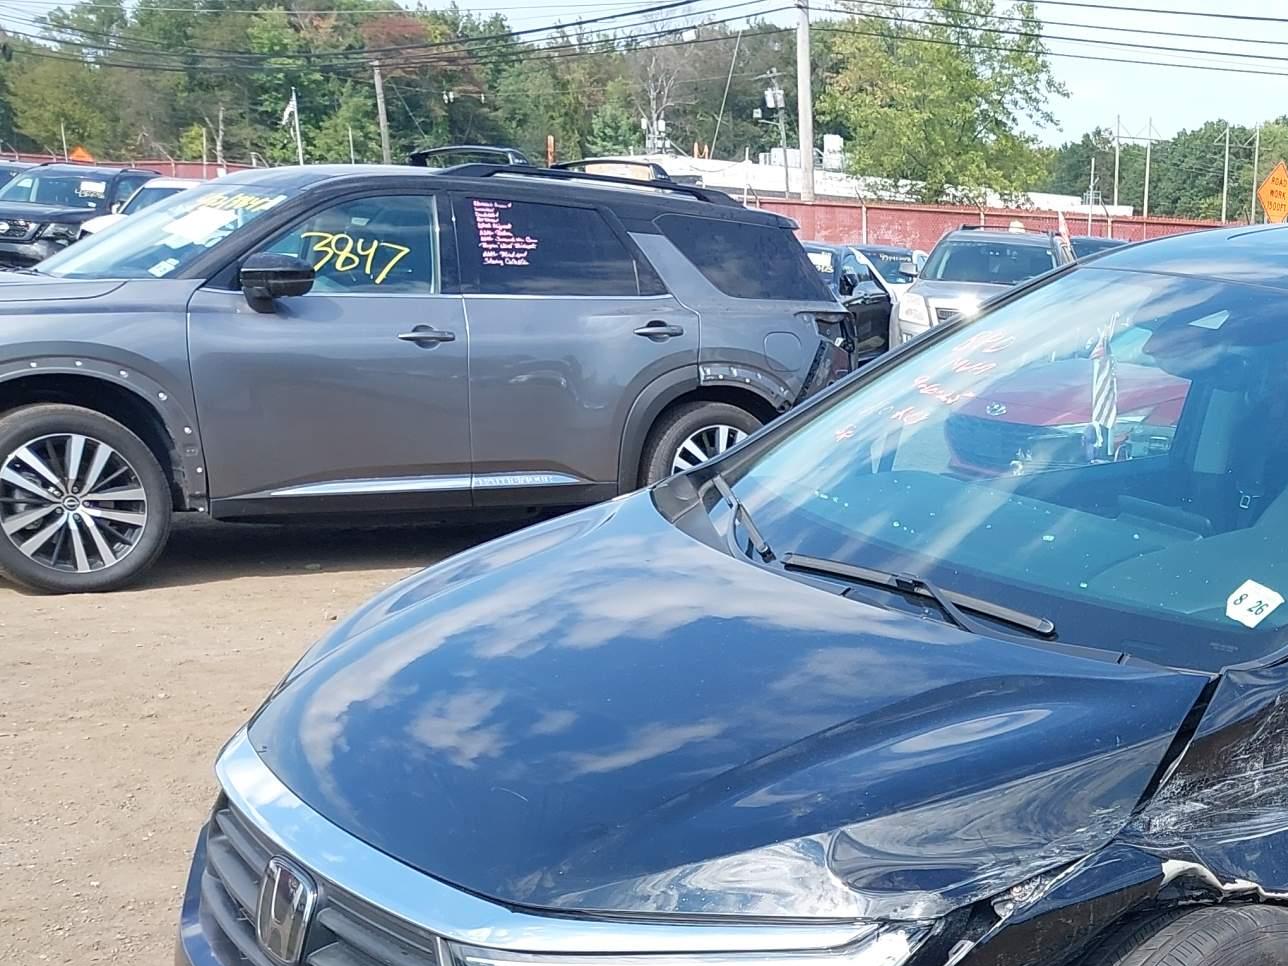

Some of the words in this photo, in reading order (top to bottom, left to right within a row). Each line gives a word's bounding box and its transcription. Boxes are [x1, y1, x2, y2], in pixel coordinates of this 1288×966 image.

[1271, 176, 1288, 188] ROAD
[1270, 190, 1286, 200] WORK
[300, 231, 411, 284] 3847
[1233, 593, 1249, 605] 8
[1247, 600, 1270, 615] 26
